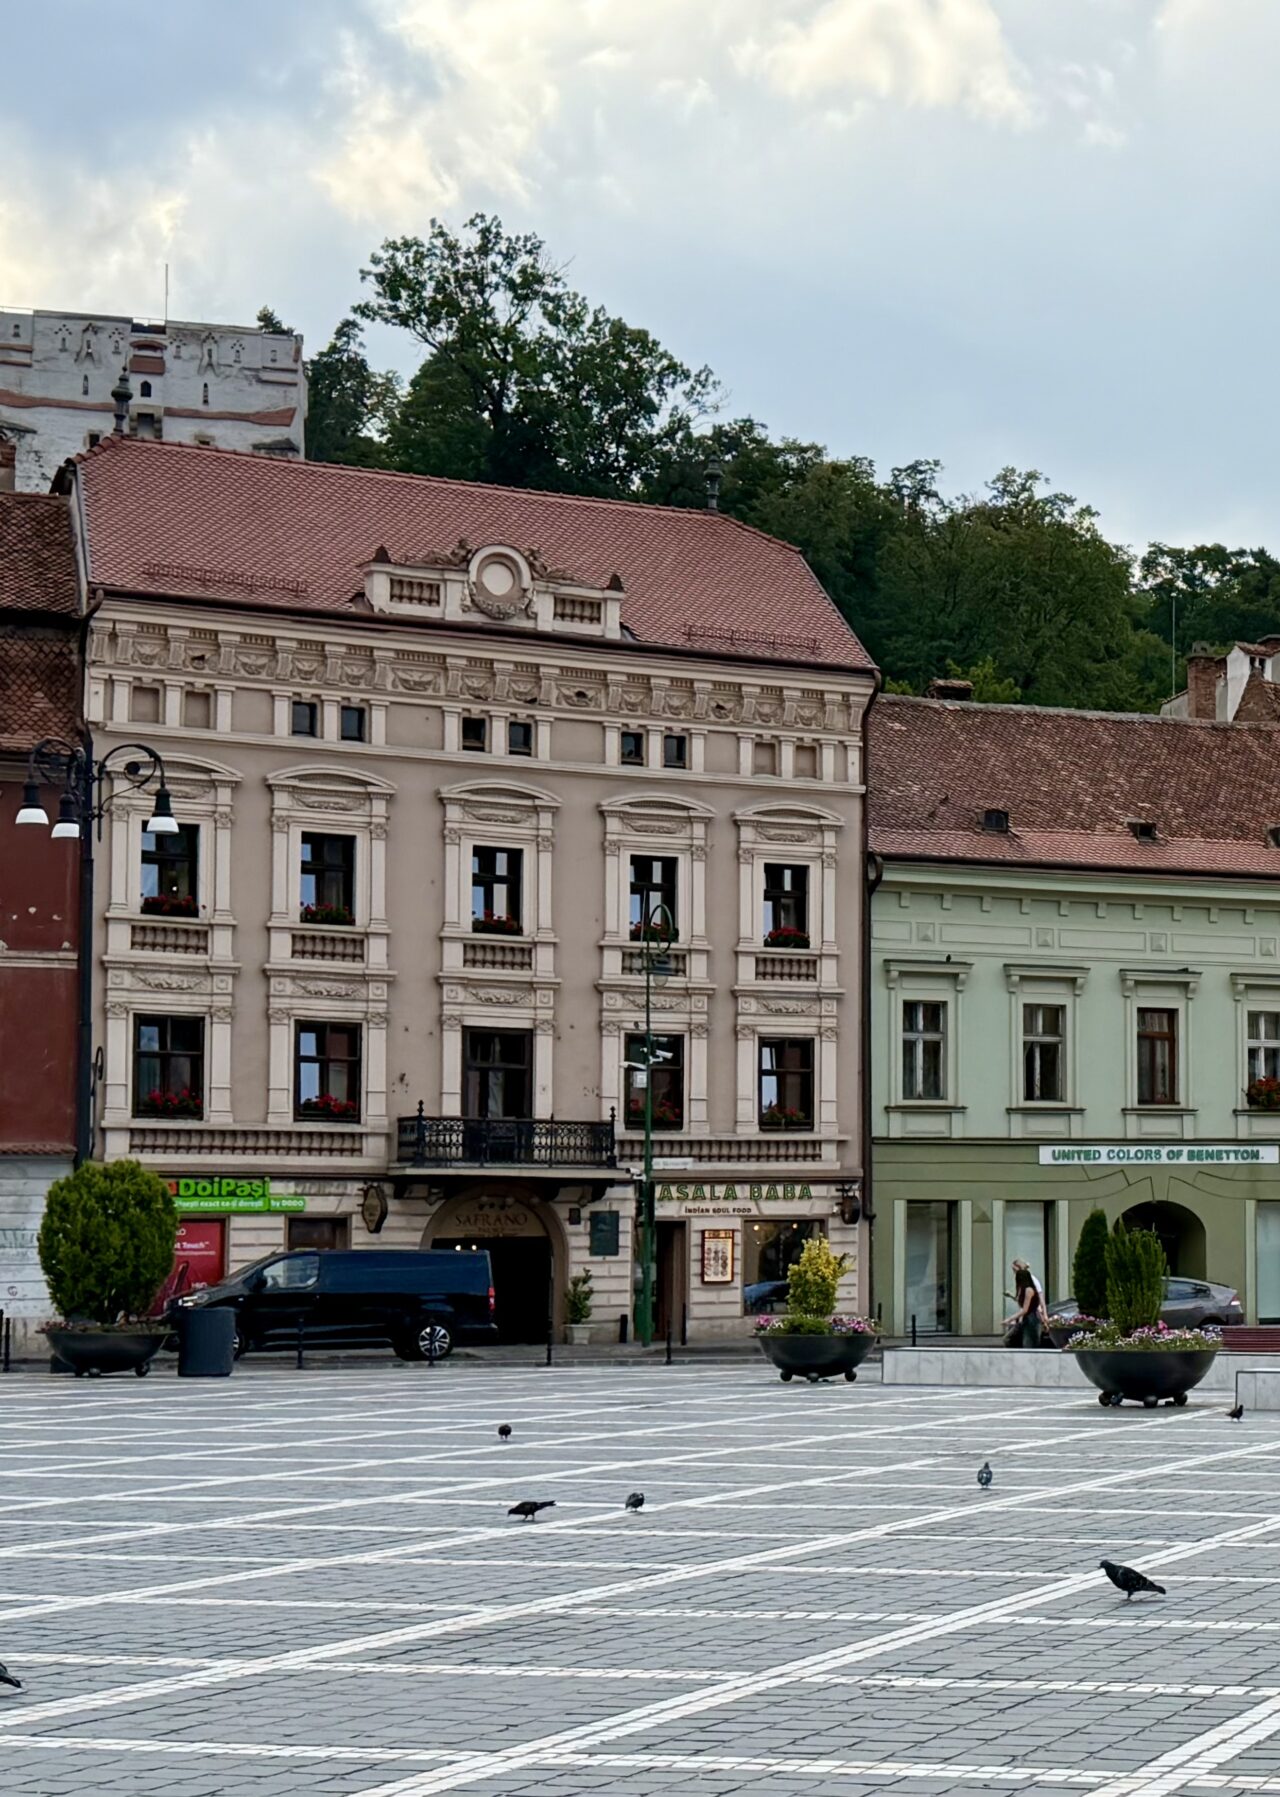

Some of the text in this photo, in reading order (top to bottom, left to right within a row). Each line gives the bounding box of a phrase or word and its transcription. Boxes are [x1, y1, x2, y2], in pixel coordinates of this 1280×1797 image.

[1051, 1149, 1101, 1161] UNITED
[1106, 1149, 1162, 1161] COLORS
[1166, 1149, 1183, 1161] OF
[657, 1183, 813, 1201] ASALA BABA
[455, 1212, 528, 1226] SAFRANO
